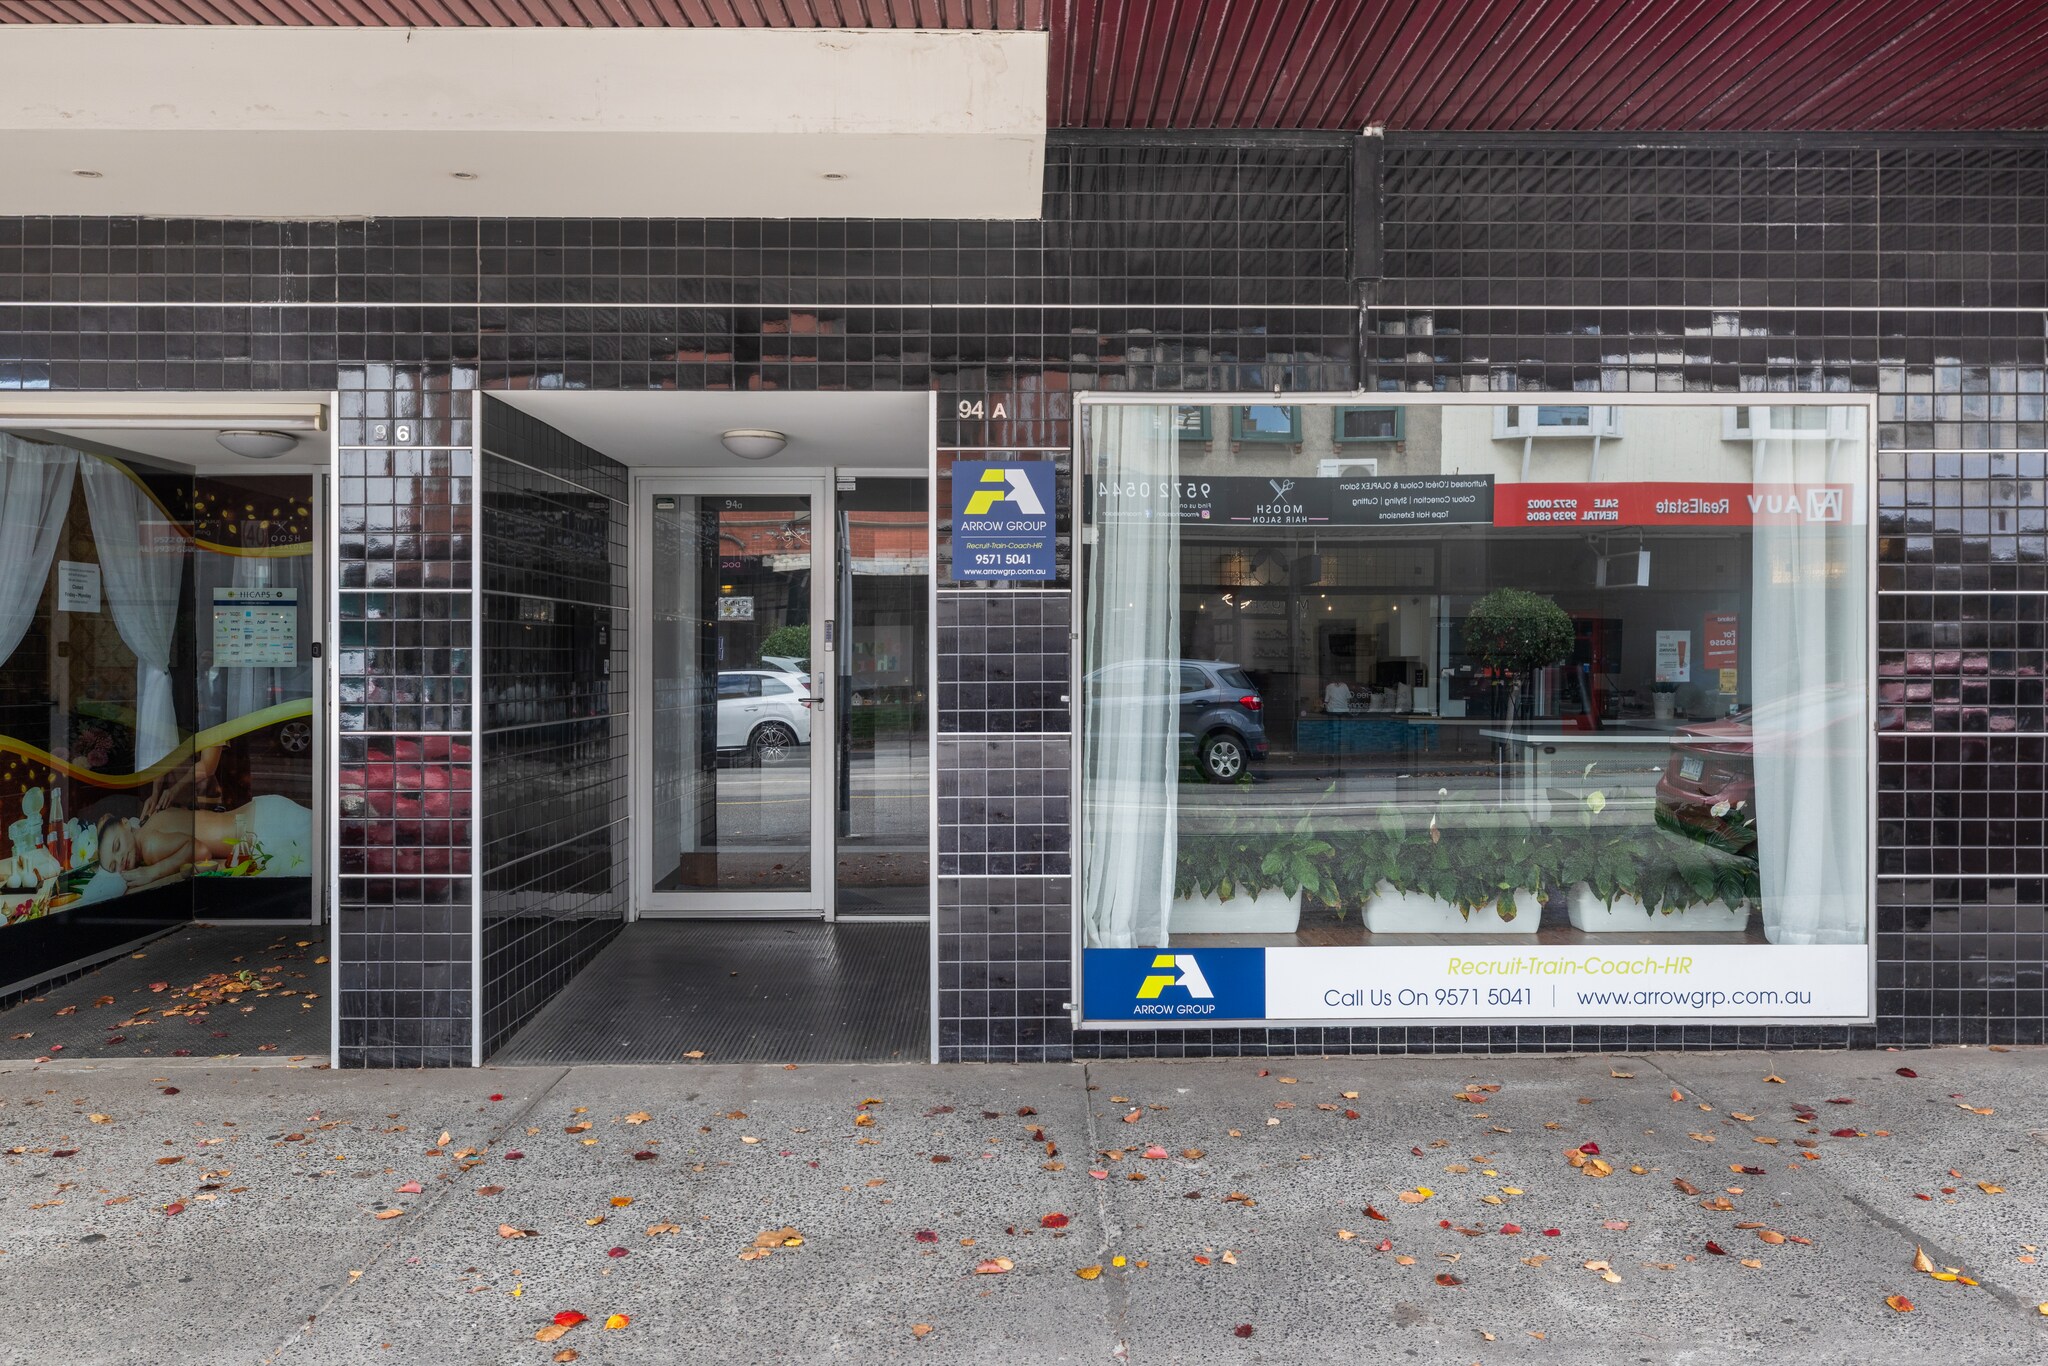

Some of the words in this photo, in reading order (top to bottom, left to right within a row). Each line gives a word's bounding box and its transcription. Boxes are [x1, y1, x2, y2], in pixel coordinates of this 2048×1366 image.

[959, 400, 984, 420] 94
[992, 403, 1007, 418] A
[375, 424, 410, 441] 96
[725, 500, 743, 509] 94a
[961, 521, 1003, 531] ARROW
[1006, 521, 1047, 531] GROUP
[975, 554, 1001, 565] 9571
[1005, 554, 1031, 565] 5041
[964, 568, 1046, 576] www.arrowgrp.com.au
[1447, 957, 1693, 975] Recruit-Train-Coach-HR
[1324, 988, 1364, 1007] Call
[1370, 989, 1393, 1006] Us
[1398, 989, 1429, 1006] On
[1434, 988, 1479, 1006] 9571
[1488, 988, 1532, 1006] 5041
[1577, 988, 1812, 1009] www.arrowgrp.com.au
[1133, 1004, 1174, 1015] ARROW
[1177, 1004, 1216, 1015] GROUP
